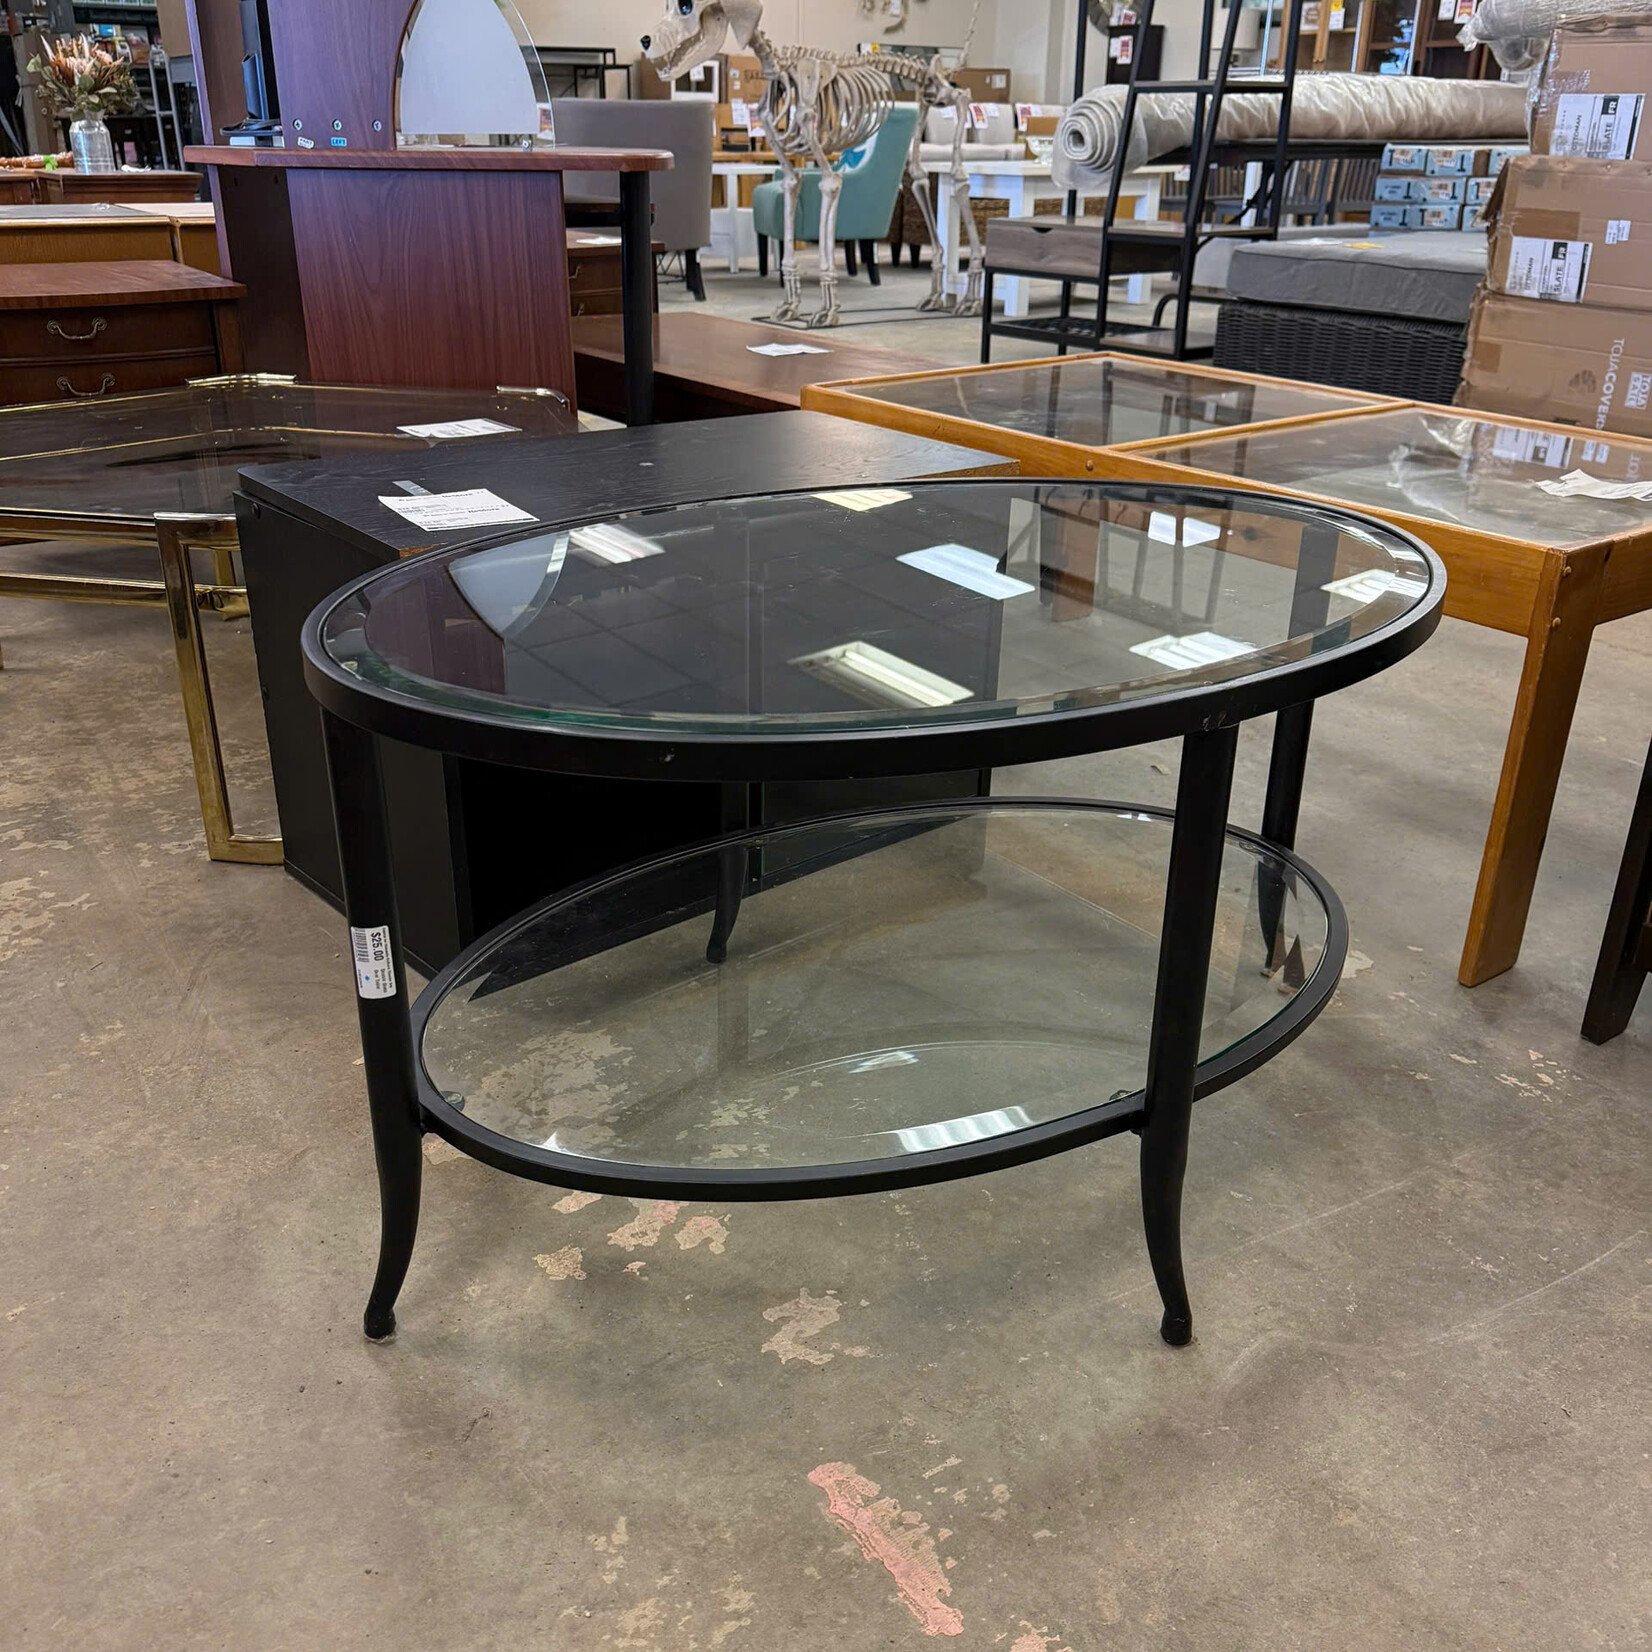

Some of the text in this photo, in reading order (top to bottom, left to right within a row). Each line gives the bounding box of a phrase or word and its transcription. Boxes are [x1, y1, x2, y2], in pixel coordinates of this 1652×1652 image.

[1607, 101, 1617, 114] FR
[1558, 247, 1568, 260] FR
[371, 932, 384, 961] $25.00
